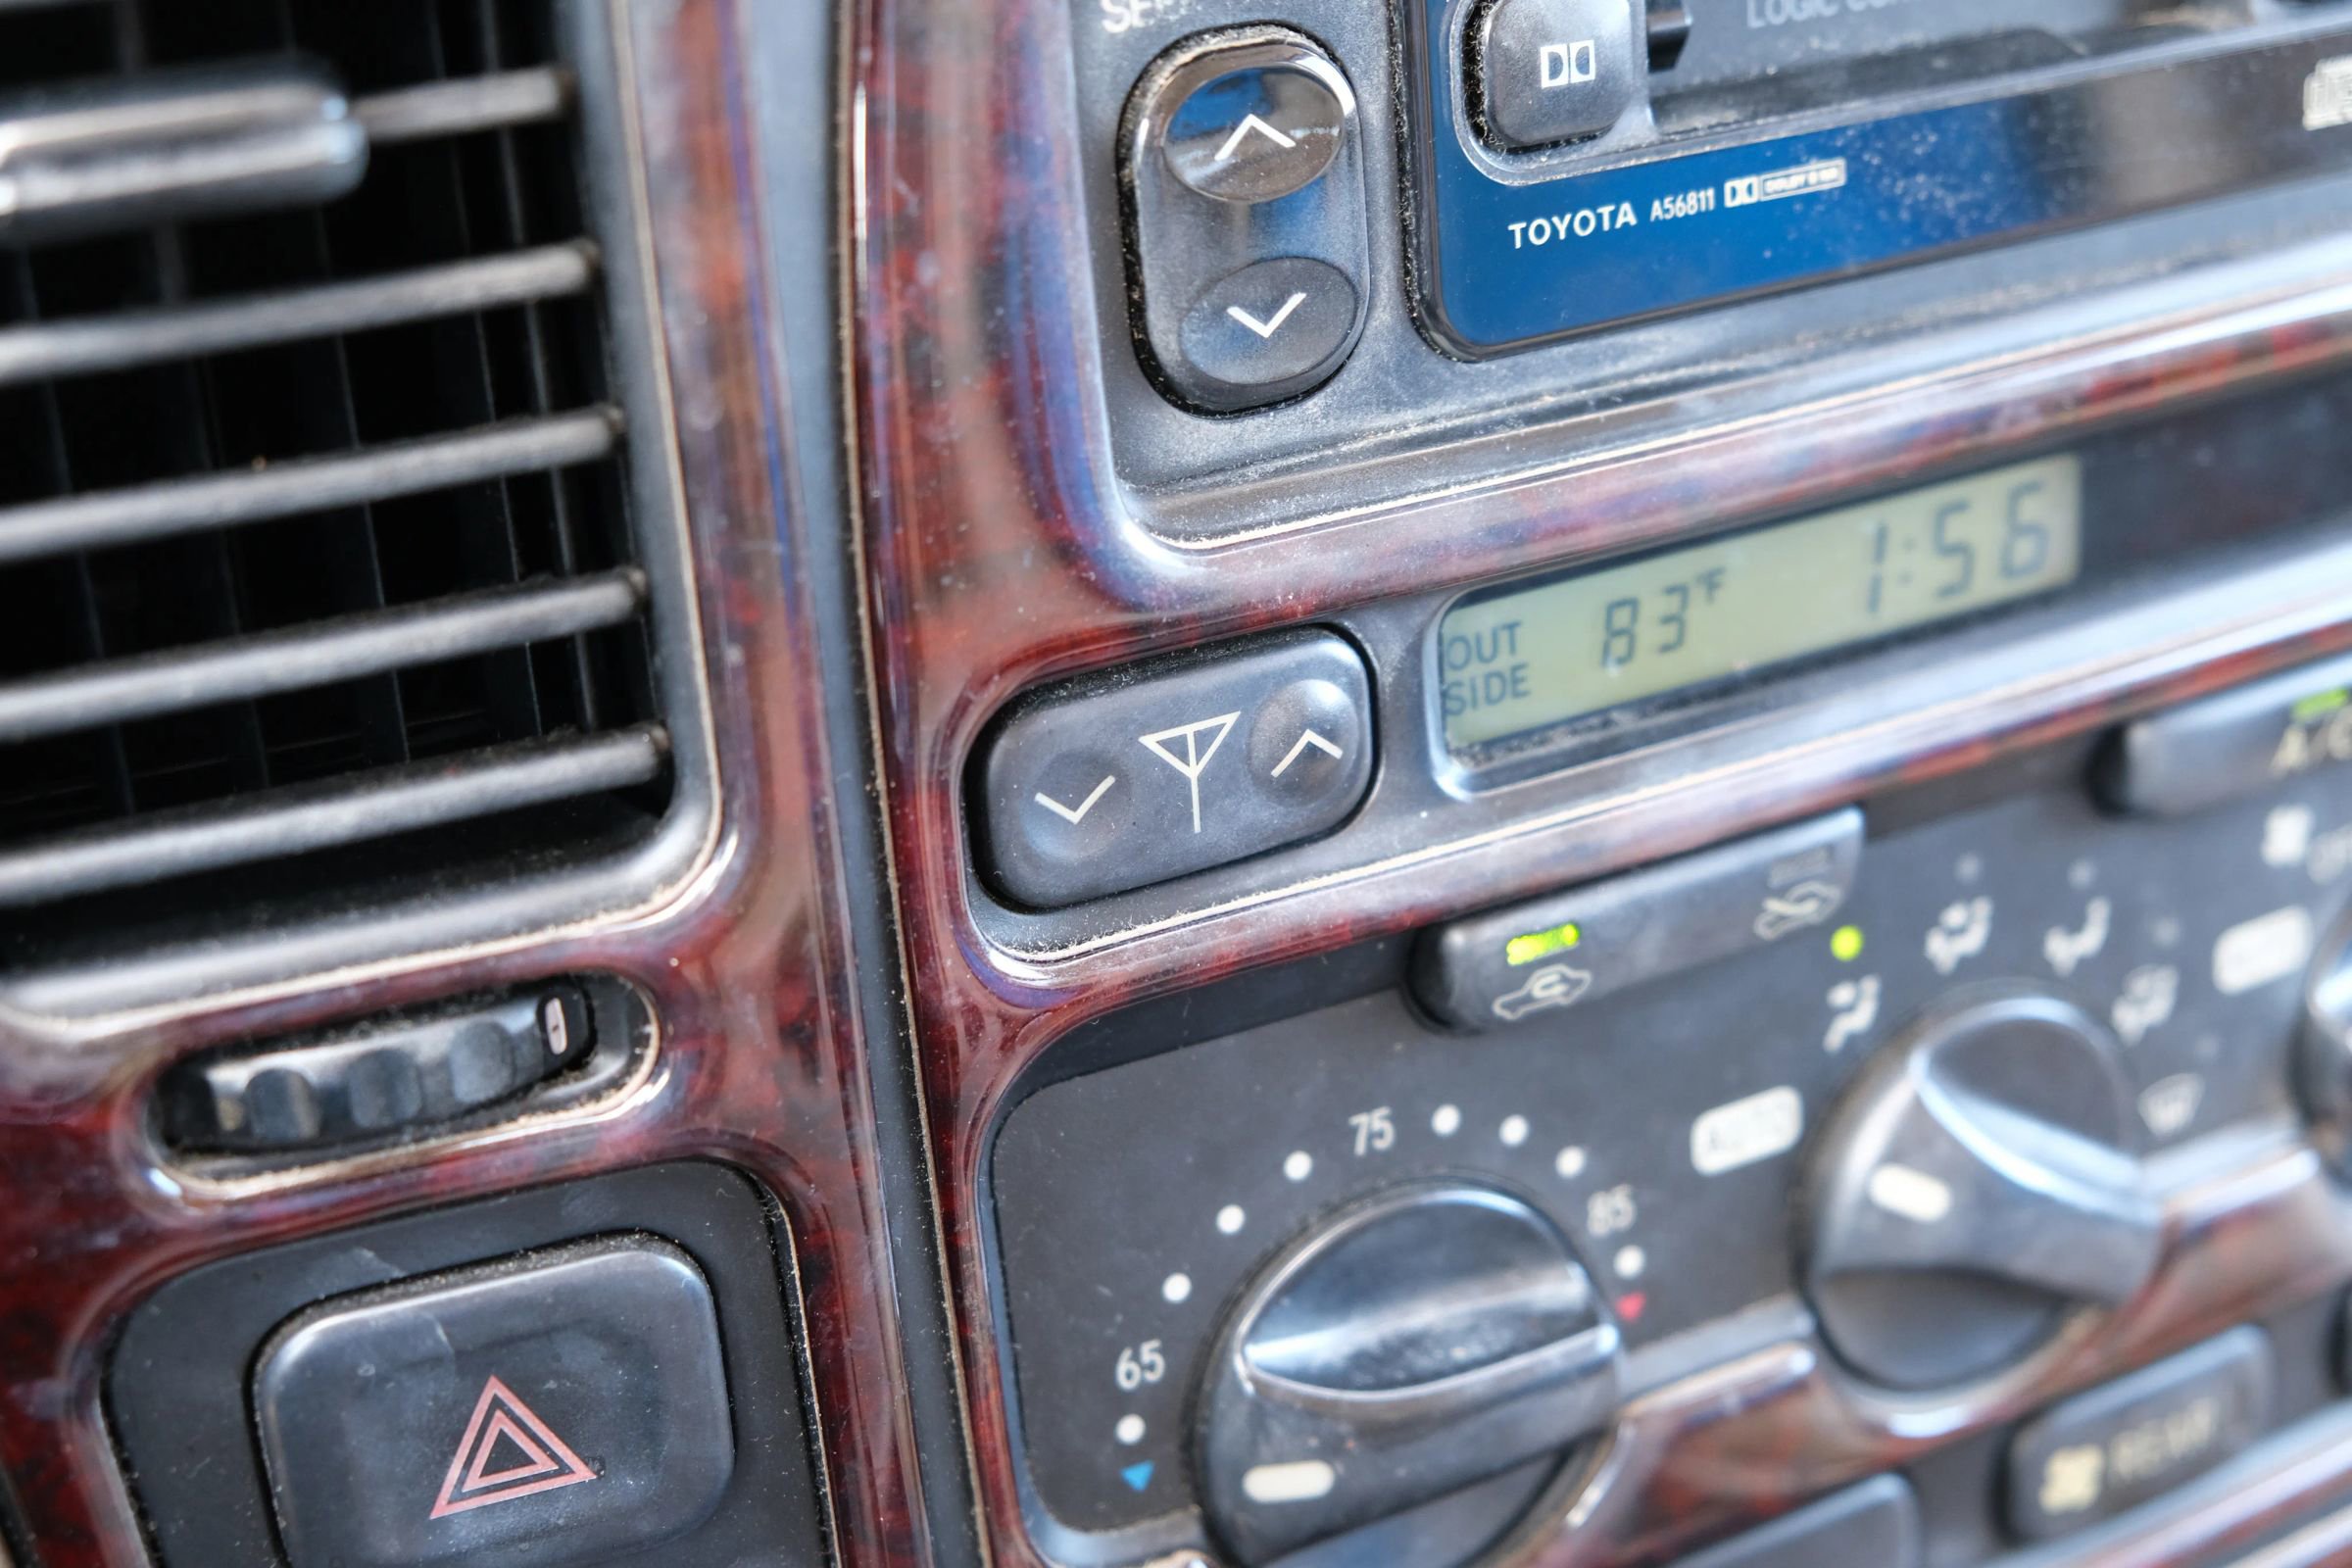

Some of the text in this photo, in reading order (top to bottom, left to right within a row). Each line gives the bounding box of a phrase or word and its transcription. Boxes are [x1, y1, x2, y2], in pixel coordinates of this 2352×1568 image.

[1507, 188, 1715, 249] TOYOTA A56811
[1867, 481, 2049, 612] 1:56
[1446, 621, 1523, 671] OUT
[1442, 663, 1531, 716] SIDE
[1348, 1105, 1396, 1156] 75
[1587, 1184, 1636, 1236] 85
[1115, 1338, 1165, 1391] 65
